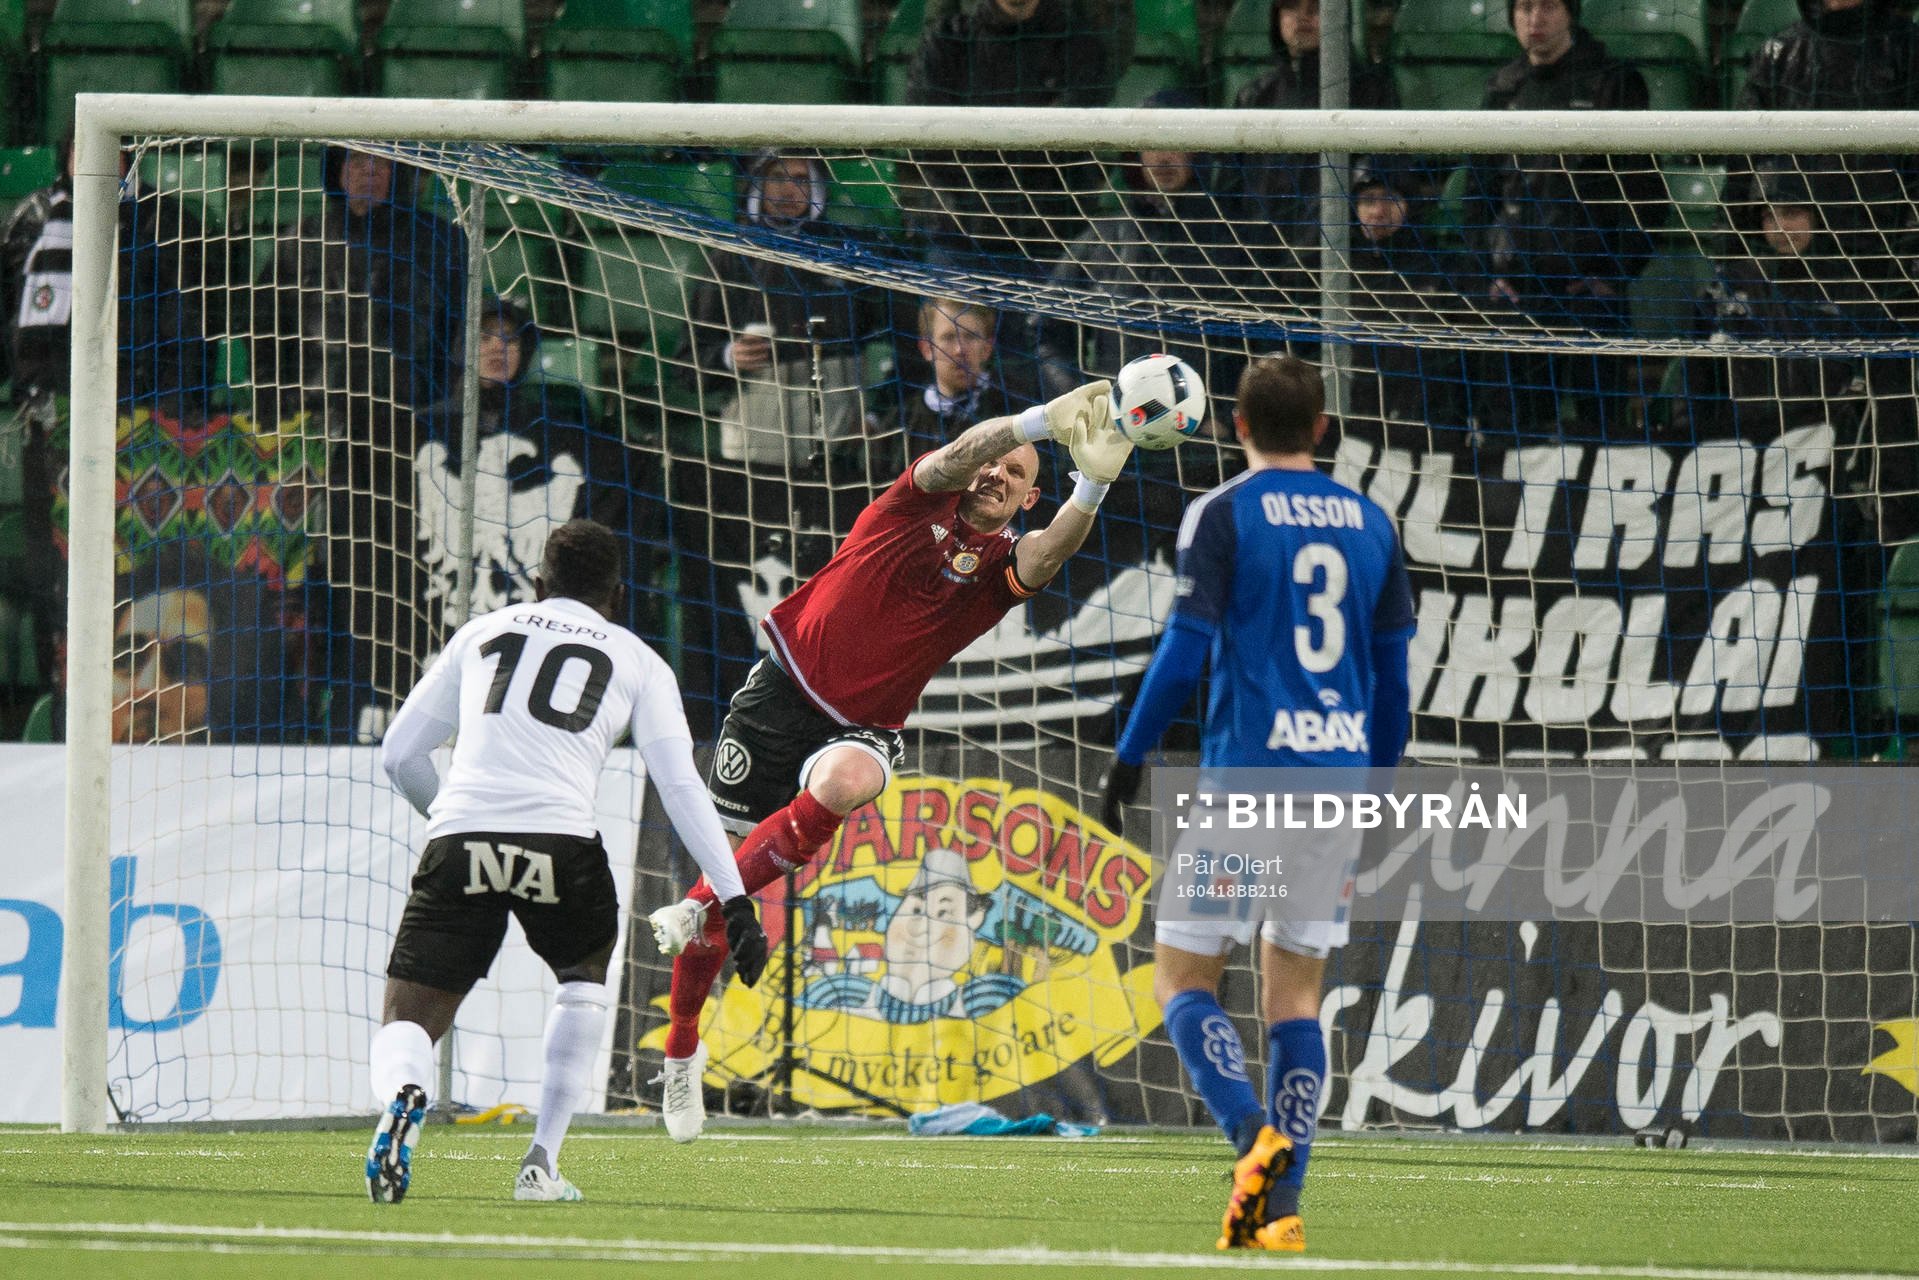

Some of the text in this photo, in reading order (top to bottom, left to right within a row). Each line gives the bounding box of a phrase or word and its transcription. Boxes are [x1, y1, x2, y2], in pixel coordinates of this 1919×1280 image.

[1261, 491, 1365, 531] OLSSON
[513, 614, 608, 641] CRESPO
[1292, 542, 1349, 674] 3
[1407, 574, 1821, 724] IKOLAI
[478, 631, 614, 734] 10
[1266, 708, 1370, 753] ABAX
[463, 841, 561, 904] NA
[827, 1048, 956, 1089] mycket
